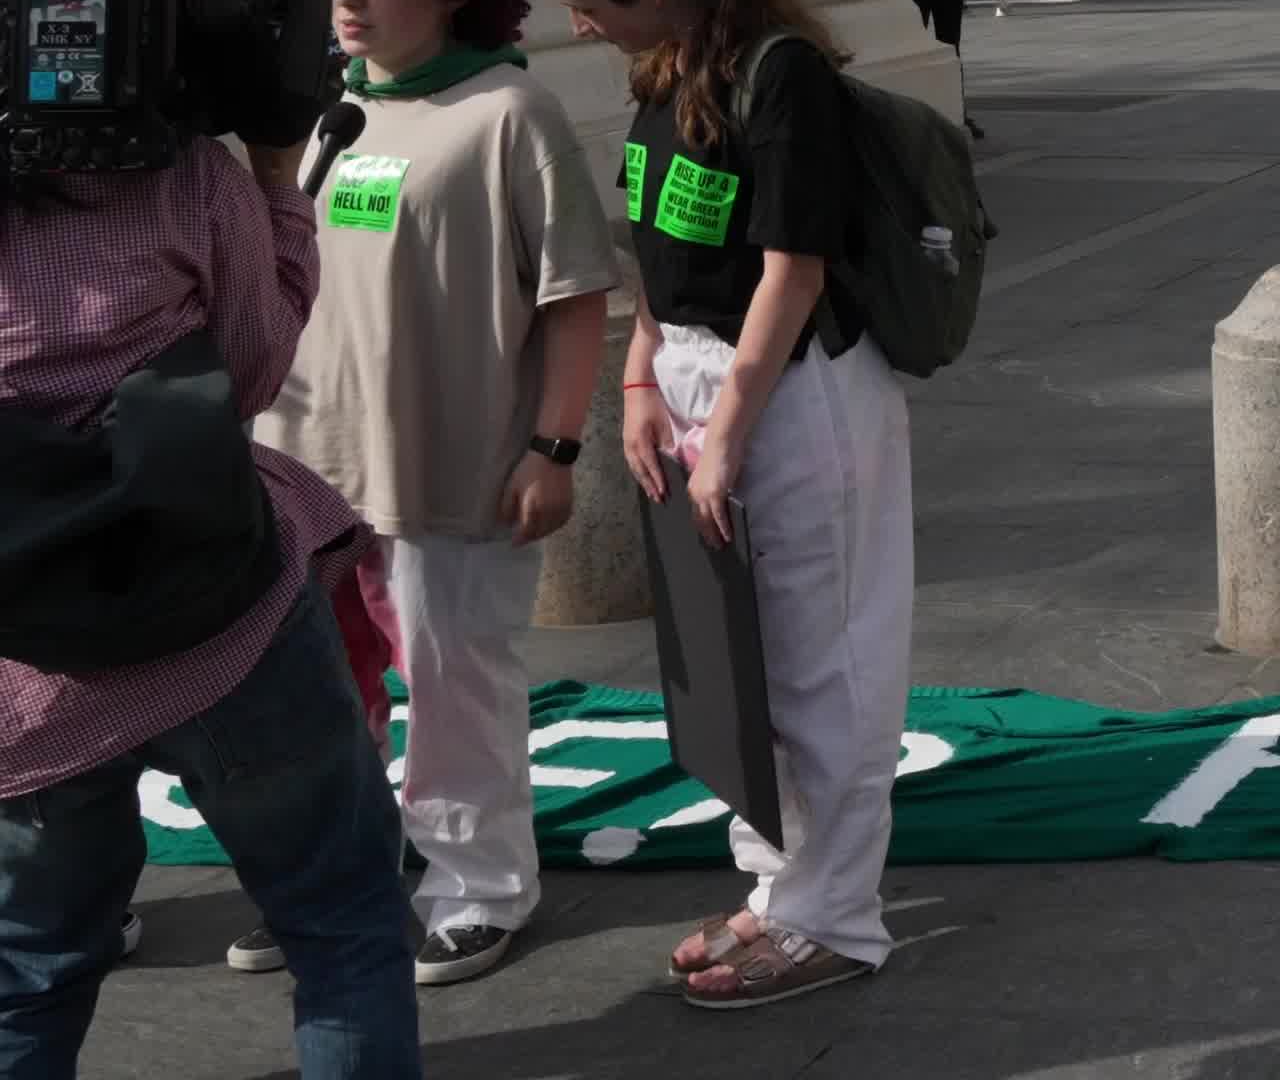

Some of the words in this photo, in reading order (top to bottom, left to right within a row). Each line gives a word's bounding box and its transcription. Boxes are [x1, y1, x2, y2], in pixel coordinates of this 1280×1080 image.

[675, 161, 697, 184] RISE
[334, 190, 364, 211] HELL
[367, 192, 391, 214] NO!
